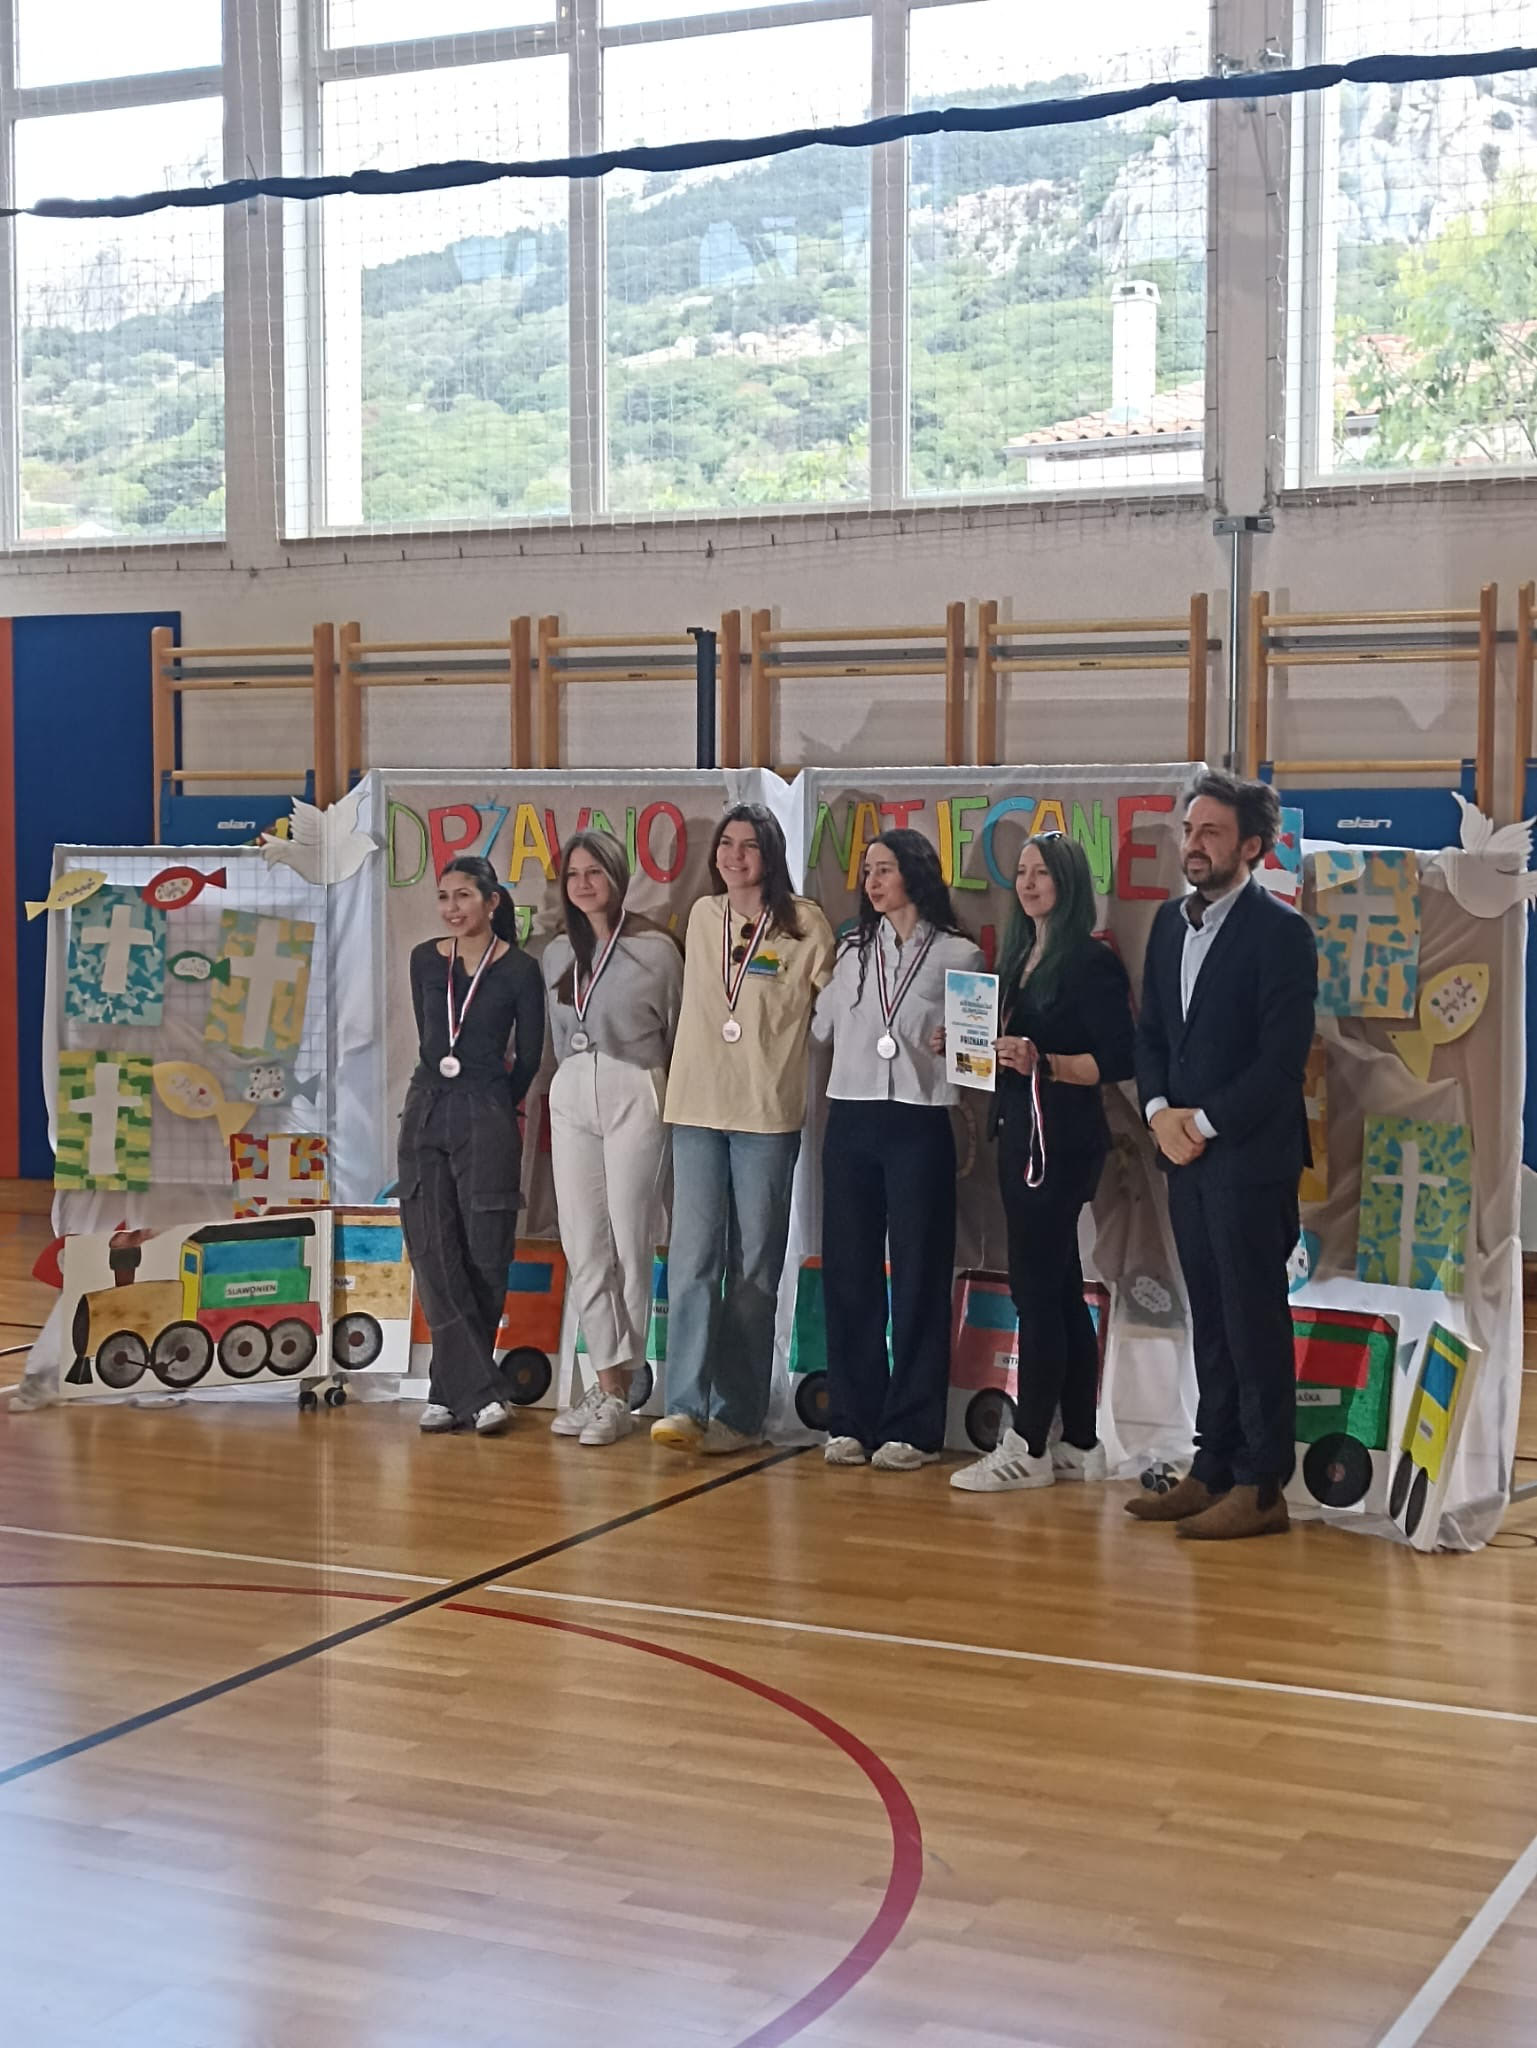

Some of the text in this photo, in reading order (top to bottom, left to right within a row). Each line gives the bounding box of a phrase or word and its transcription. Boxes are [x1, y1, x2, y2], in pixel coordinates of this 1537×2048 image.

[217, 819, 256, 829] elan
[1337, 816, 1393, 829] elan
[387, 796, 687, 888] DRŽAVNO
